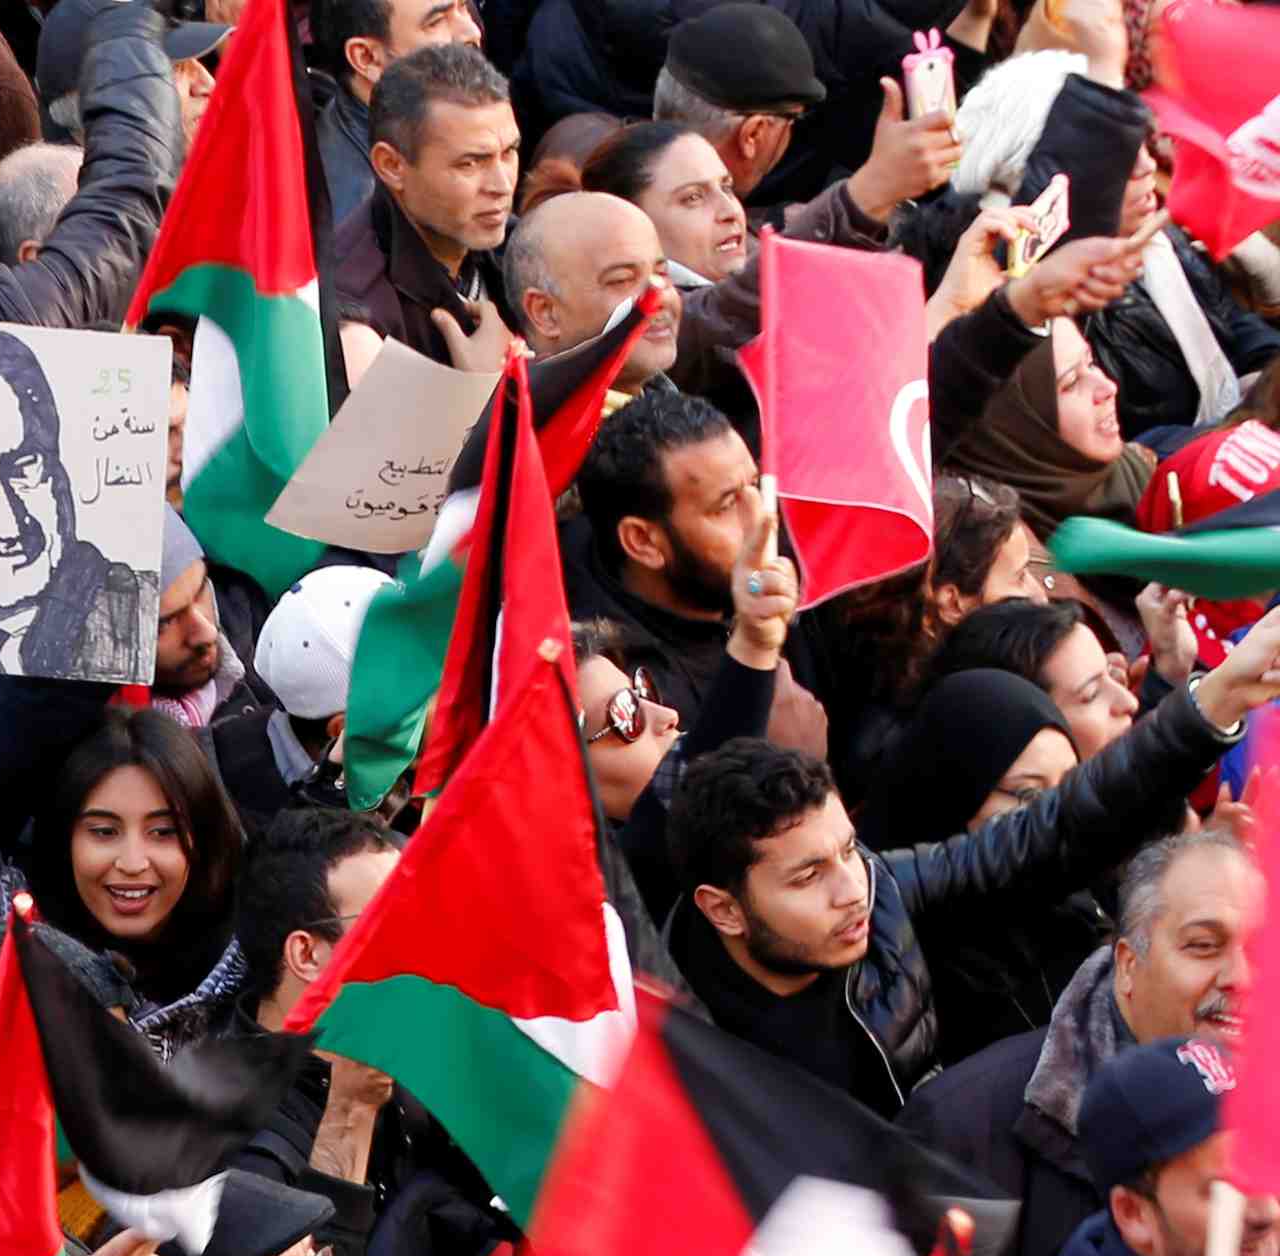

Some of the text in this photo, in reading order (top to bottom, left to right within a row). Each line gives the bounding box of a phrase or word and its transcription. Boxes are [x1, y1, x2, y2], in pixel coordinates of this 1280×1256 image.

[91, 368, 132, 394] 25
[93, 407, 155, 441] سنة من
[78, 457, 153, 504] النضال
